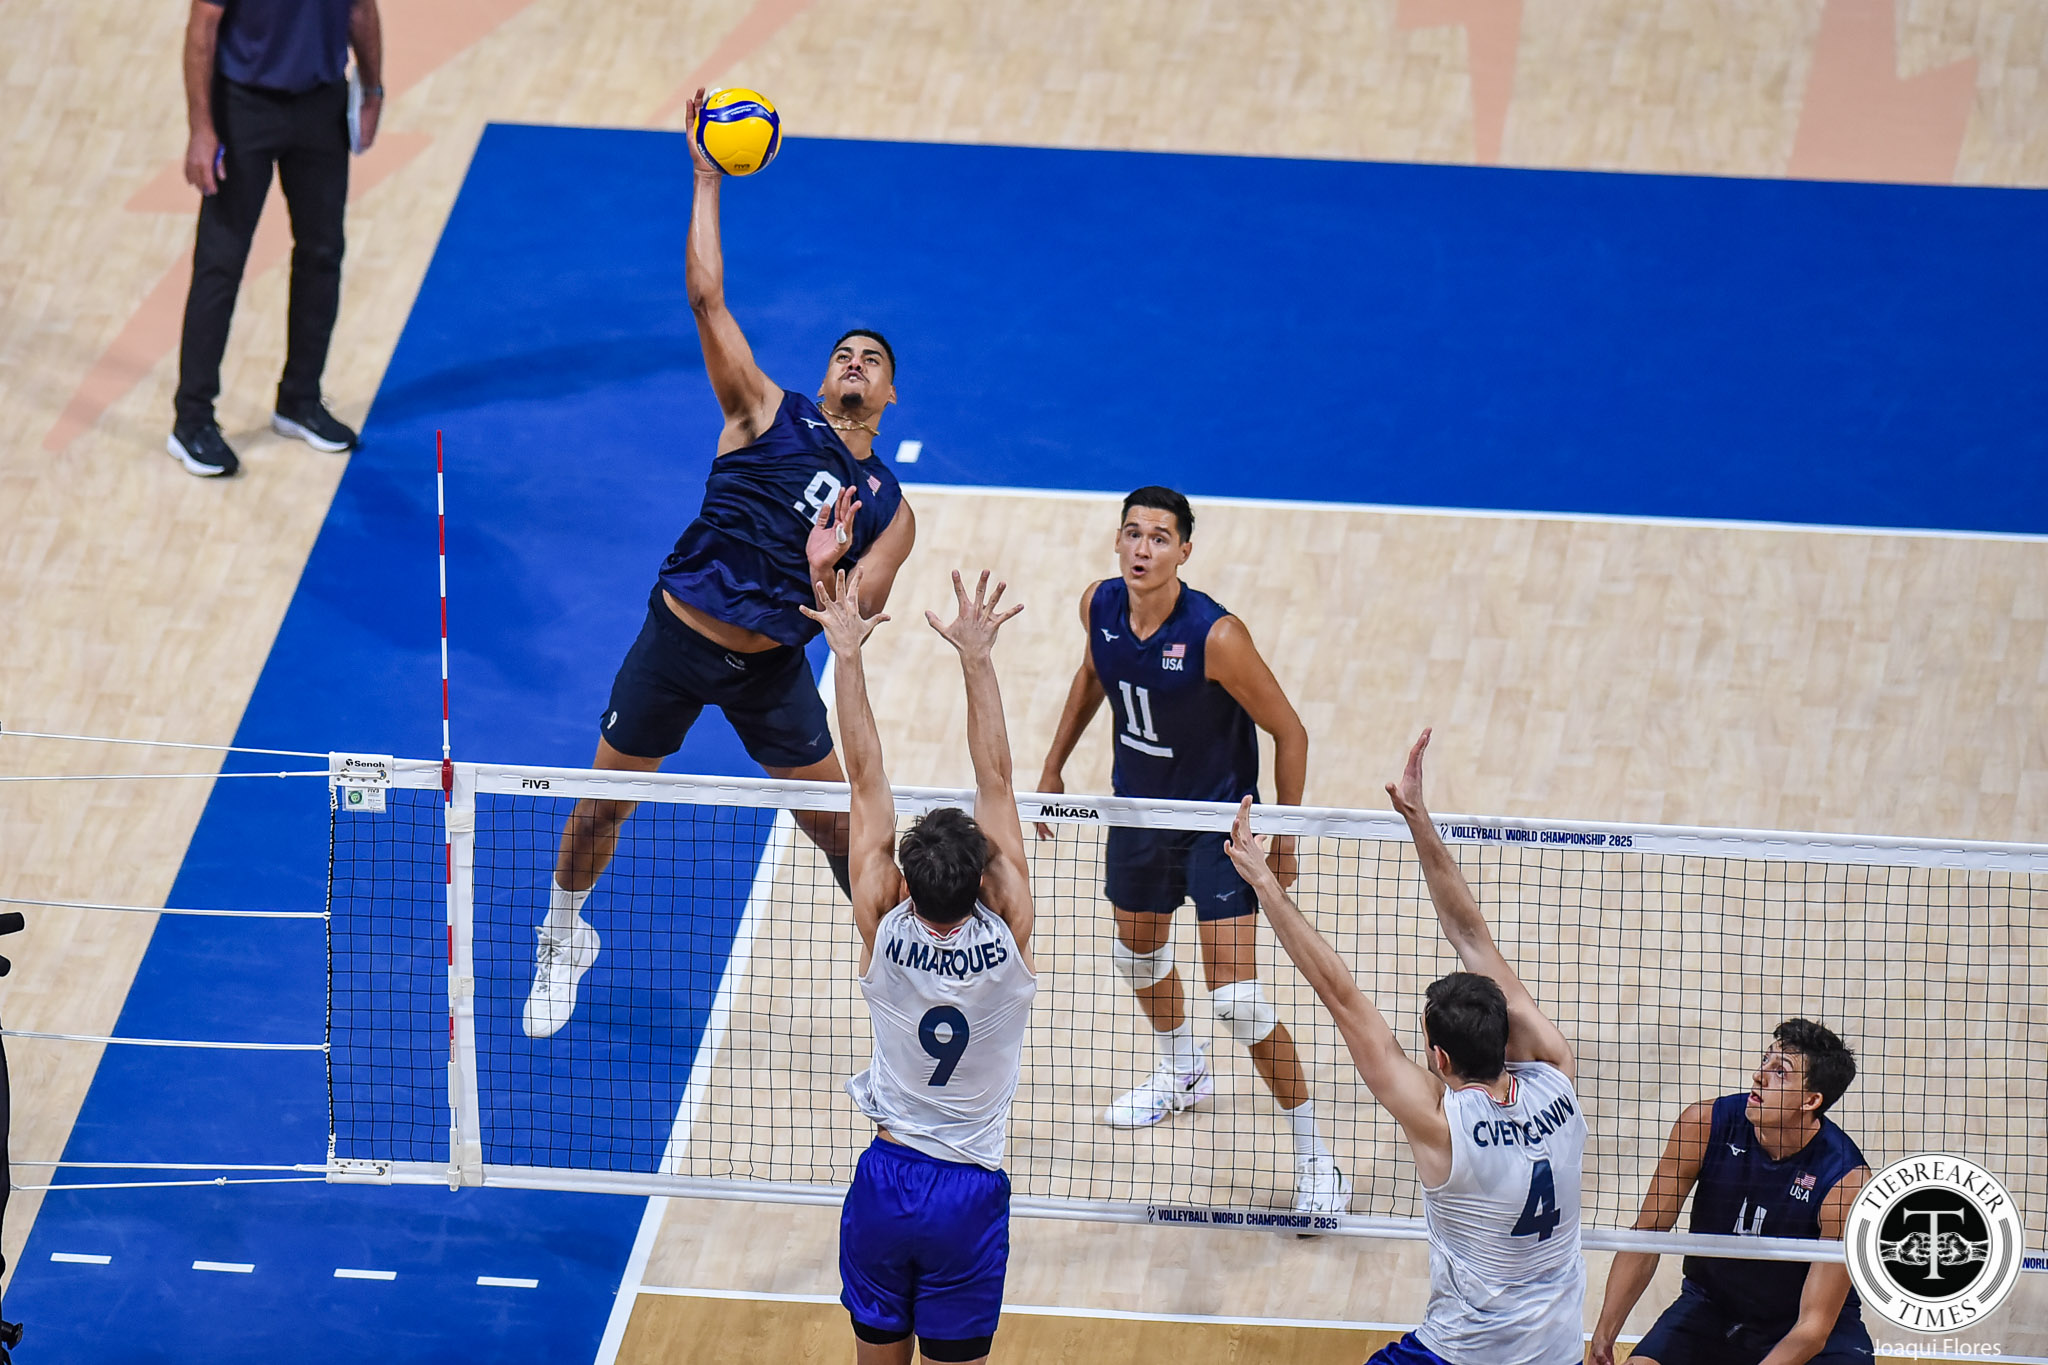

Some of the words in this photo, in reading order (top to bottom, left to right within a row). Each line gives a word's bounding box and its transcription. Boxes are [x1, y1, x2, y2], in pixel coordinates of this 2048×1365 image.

[1161, 657, 1184, 671] USA
[606, 710, 618, 730] 9
[1118, 680, 1159, 742] 11
[354, 760, 385, 768] Senoh
[521, 779, 550, 790] FIVB
[1451, 825, 1502, 841] VOLLEYBALL
[1505, 829, 1538, 842] WORLD
[1540, 831, 1606, 846] CHAMPIONSHIP
[1608, 834, 1633, 847] 2025
[918, 1005, 970, 1087] 9
[1473, 1093, 1575, 1148] CVETCANIN
[1510, 1158, 1561, 1242] 4
[1789, 1184, 1811, 1203] USA
[1157, 1208, 1208, 1223] VOLLEYBALL
[1211, 1211, 1244, 1225] WORLD
[1246, 1213, 1312, 1228] CHAMPIONSHIP
[1313, 1216, 1338, 1230] 2025
